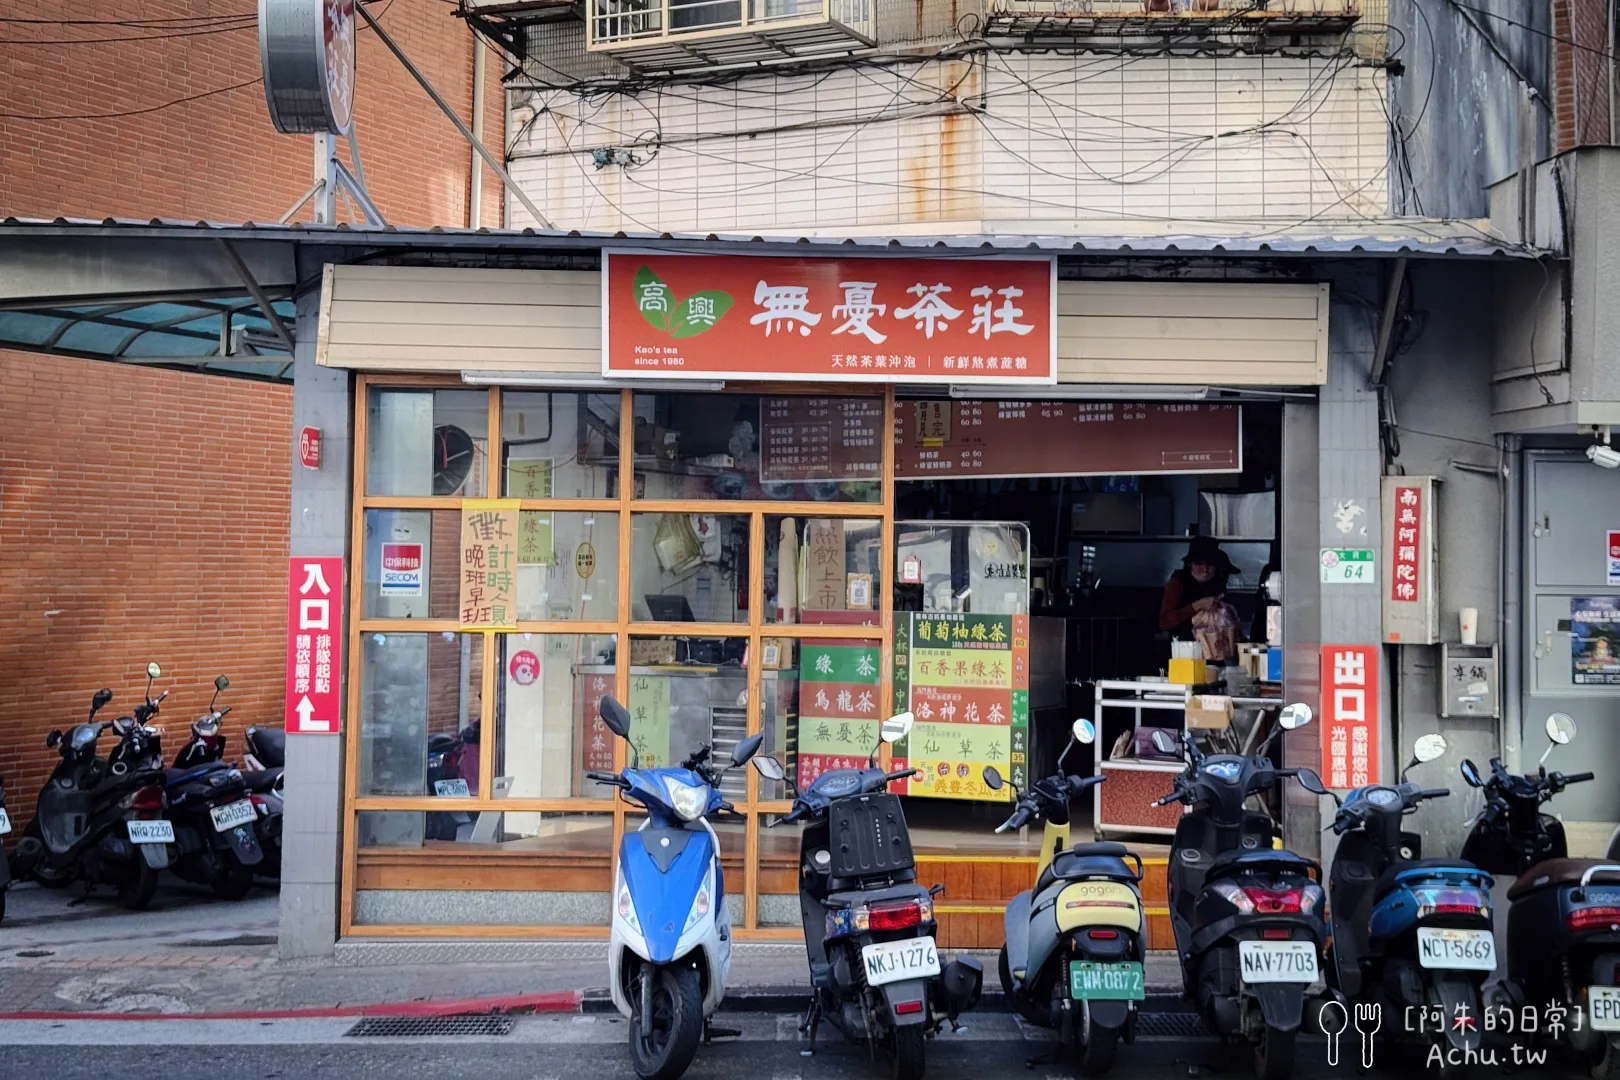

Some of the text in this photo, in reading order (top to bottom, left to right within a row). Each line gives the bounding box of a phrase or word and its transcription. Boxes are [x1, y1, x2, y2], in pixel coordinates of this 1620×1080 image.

[749, 279, 1036, 345] 無憂茶莊
[634, 345, 678, 355] Kao's tea
[634, 357, 685, 366] since 1980
[831, 354, 917, 369] 天然茶葉沖泡
[523, 463, 540, 554] 百香綠茶
[1396, 488, 1418, 600] 南無阿彌陀佛
[385, 557, 419, 568] 中保科技
[813, 524, 842, 609] 熱飲上市
[1344, 564, 1364, 579] 64
[385, 573, 419, 582] SECOM
[462, 543, 492, 624] 晚班早班
[486, 543, 514, 626] 計時人員
[299, 563, 332, 630] 入口
[918, 620, 1008, 642] 葡萄柚綠茶
[295, 634, 311, 694] 請依順序
[315, 634, 332, 694] 排隊起點
[815, 653, 876, 677] 綠茶
[917, 659, 1007, 679] 百香果綠茶
[1334, 651, 1365, 721] 出口
[814, 688, 876, 713] 烏龍茶
[915, 700, 1006, 723] 洛神花茶
[633, 677, 649, 752] 仙草茶
[814, 722, 875, 744] 無憂茶
[923, 739, 1004, 760] 仙草茶
[1331, 725, 1347, 788] 光臨惠顧
[1352, 725, 1368, 788] 感謝您的
[214, 804, 255, 826] MGH-0352
[867, 945, 936, 976] NKJ-1276
[1423, 938, 1491, 960] NCT-5669
[1244, 951, 1315, 972] NAV-7703
[1072, 970, 1141, 990] EWM-0872
